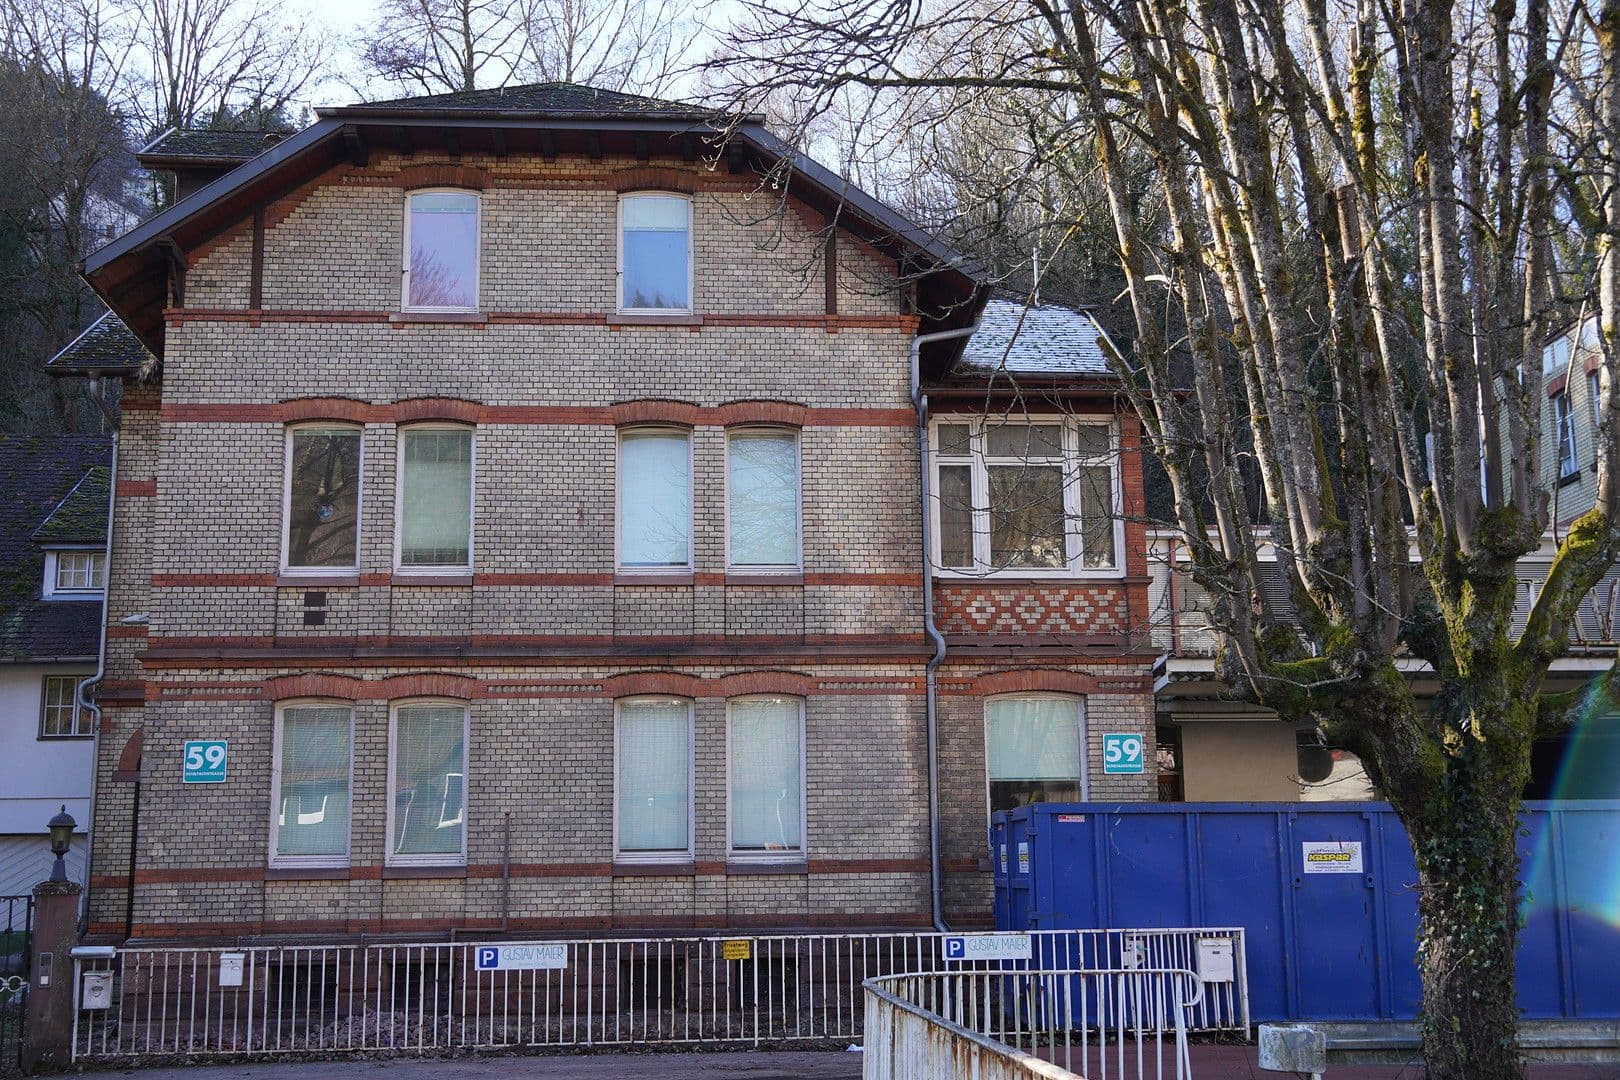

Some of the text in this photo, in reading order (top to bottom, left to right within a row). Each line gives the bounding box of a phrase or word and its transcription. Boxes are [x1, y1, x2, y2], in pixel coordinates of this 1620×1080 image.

[186, 745, 225, 770] 59
[1105, 738, 1141, 762] 59
[949, 940, 961, 956] P
[967, 937, 1028, 952] GUSTAV MAIER
[482, 950, 495, 966] P
[502, 945, 564, 961] GUSTAV MAIER
